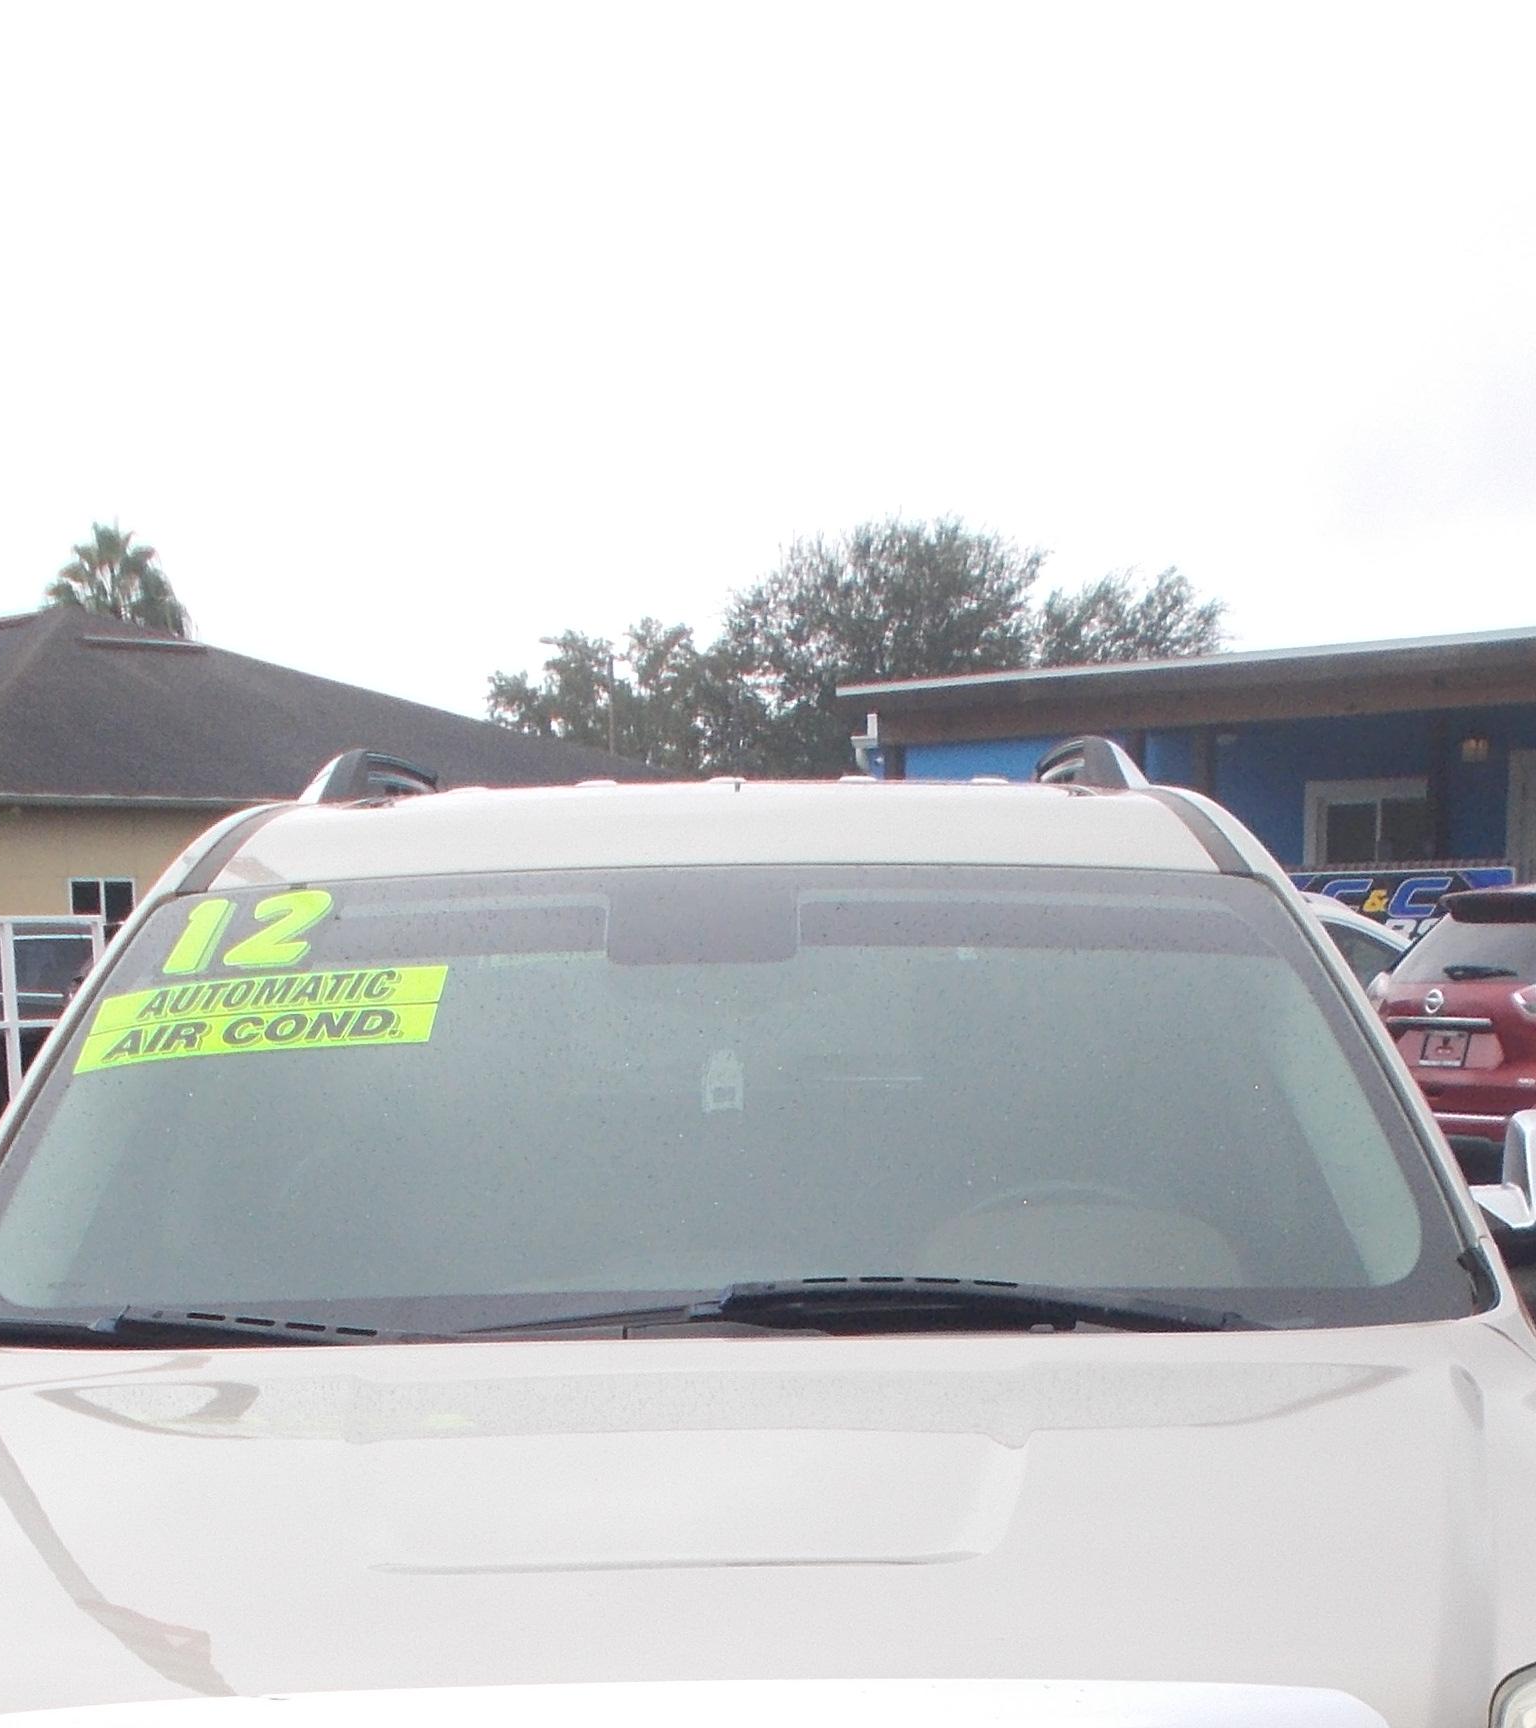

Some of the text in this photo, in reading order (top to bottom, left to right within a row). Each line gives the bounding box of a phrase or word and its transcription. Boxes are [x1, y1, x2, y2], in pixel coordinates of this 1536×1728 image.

[162, 889, 335, 975] 12
[136, 968, 401, 1022] AUTOMATIC
[100, 1008, 402, 1063] AIR COND.
